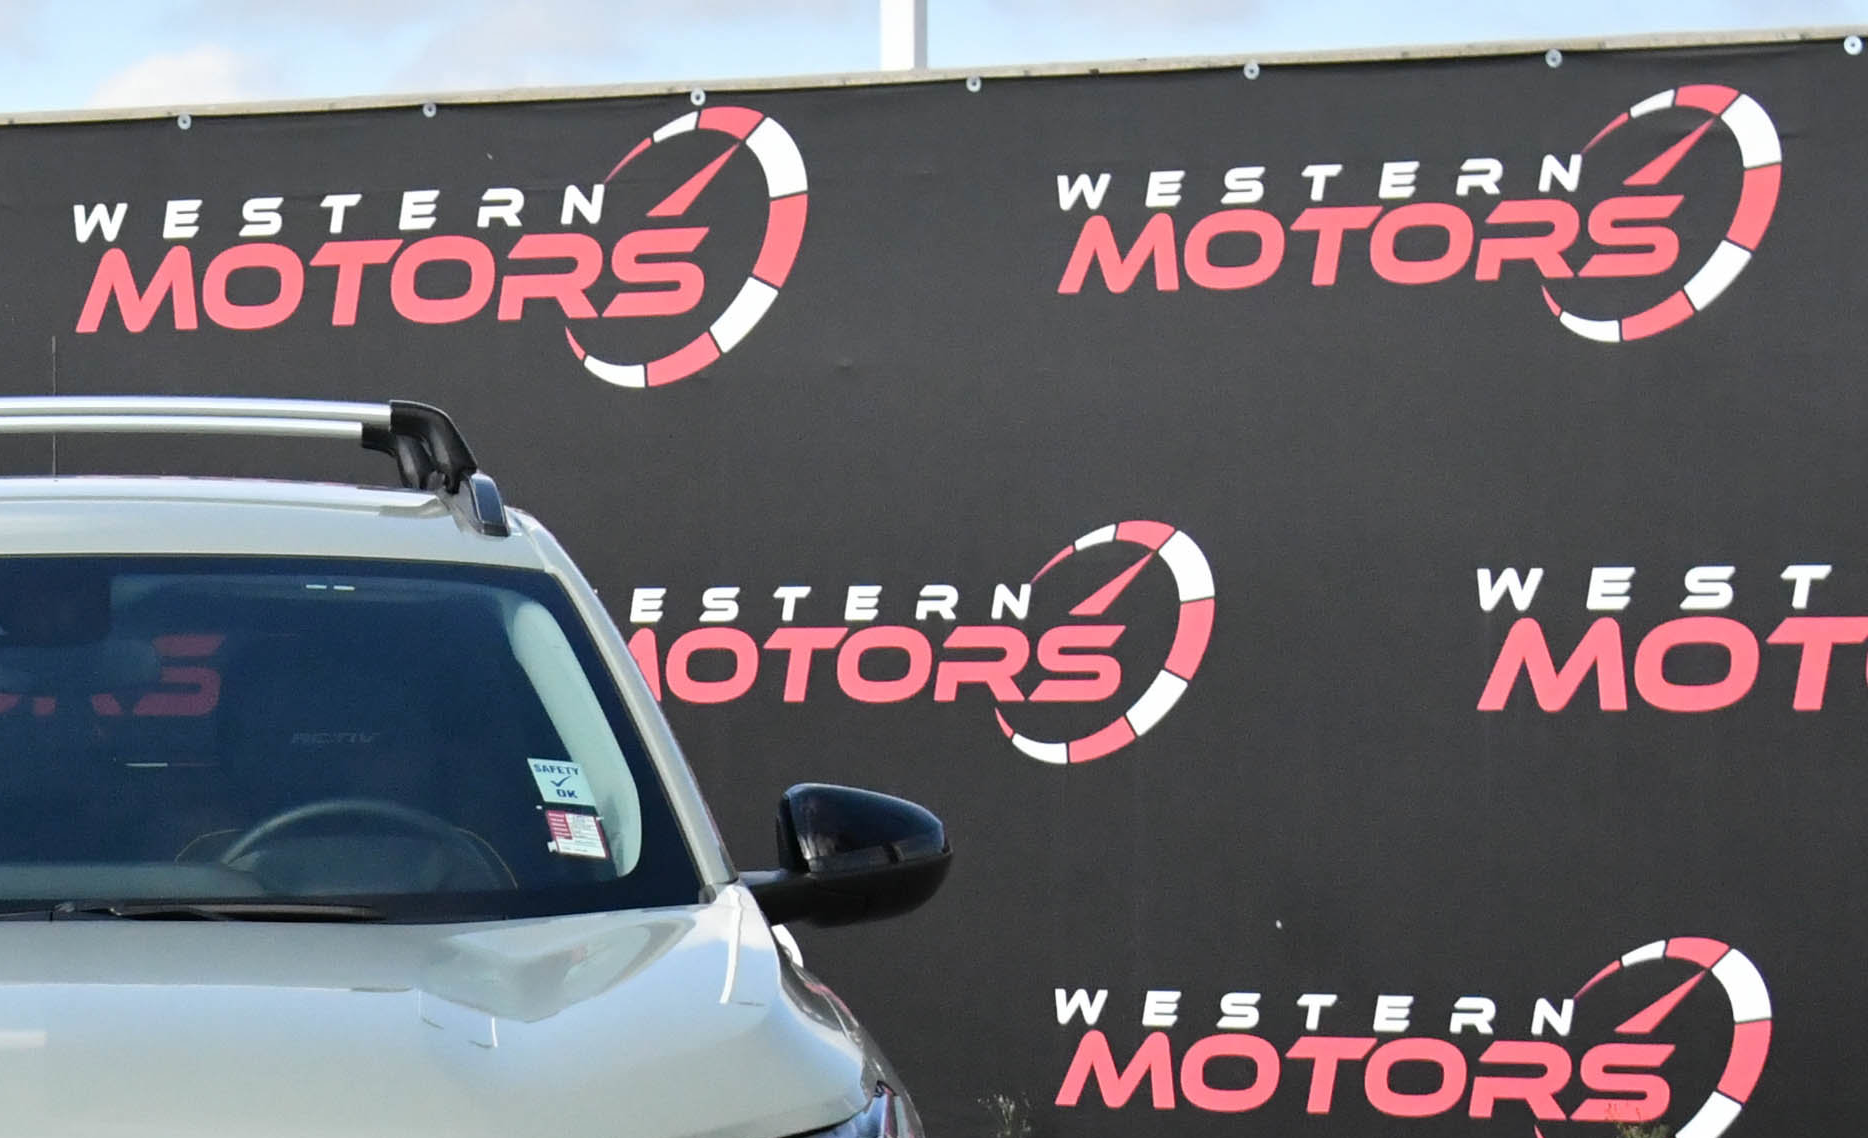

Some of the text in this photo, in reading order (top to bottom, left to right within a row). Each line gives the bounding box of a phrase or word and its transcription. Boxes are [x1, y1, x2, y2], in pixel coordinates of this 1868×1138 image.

[1056, 153, 1583, 212] WESTERN
[73, 183, 606, 244] WESTERN
[1057, 193, 1685, 295] MOTORS
[75, 225, 711, 334] MOTORS
[593, 583, 1032, 623] ESTERN
[1475, 564, 1833, 612] WEST
[1475, 615, 1868, 713] MOT
[532, 763, 580, 776] SAFETY
[556, 788, 579, 799] OK
[1054, 988, 1575, 1037] WESTERN
[1054, 1028, 1677, 1124] MOTORS
